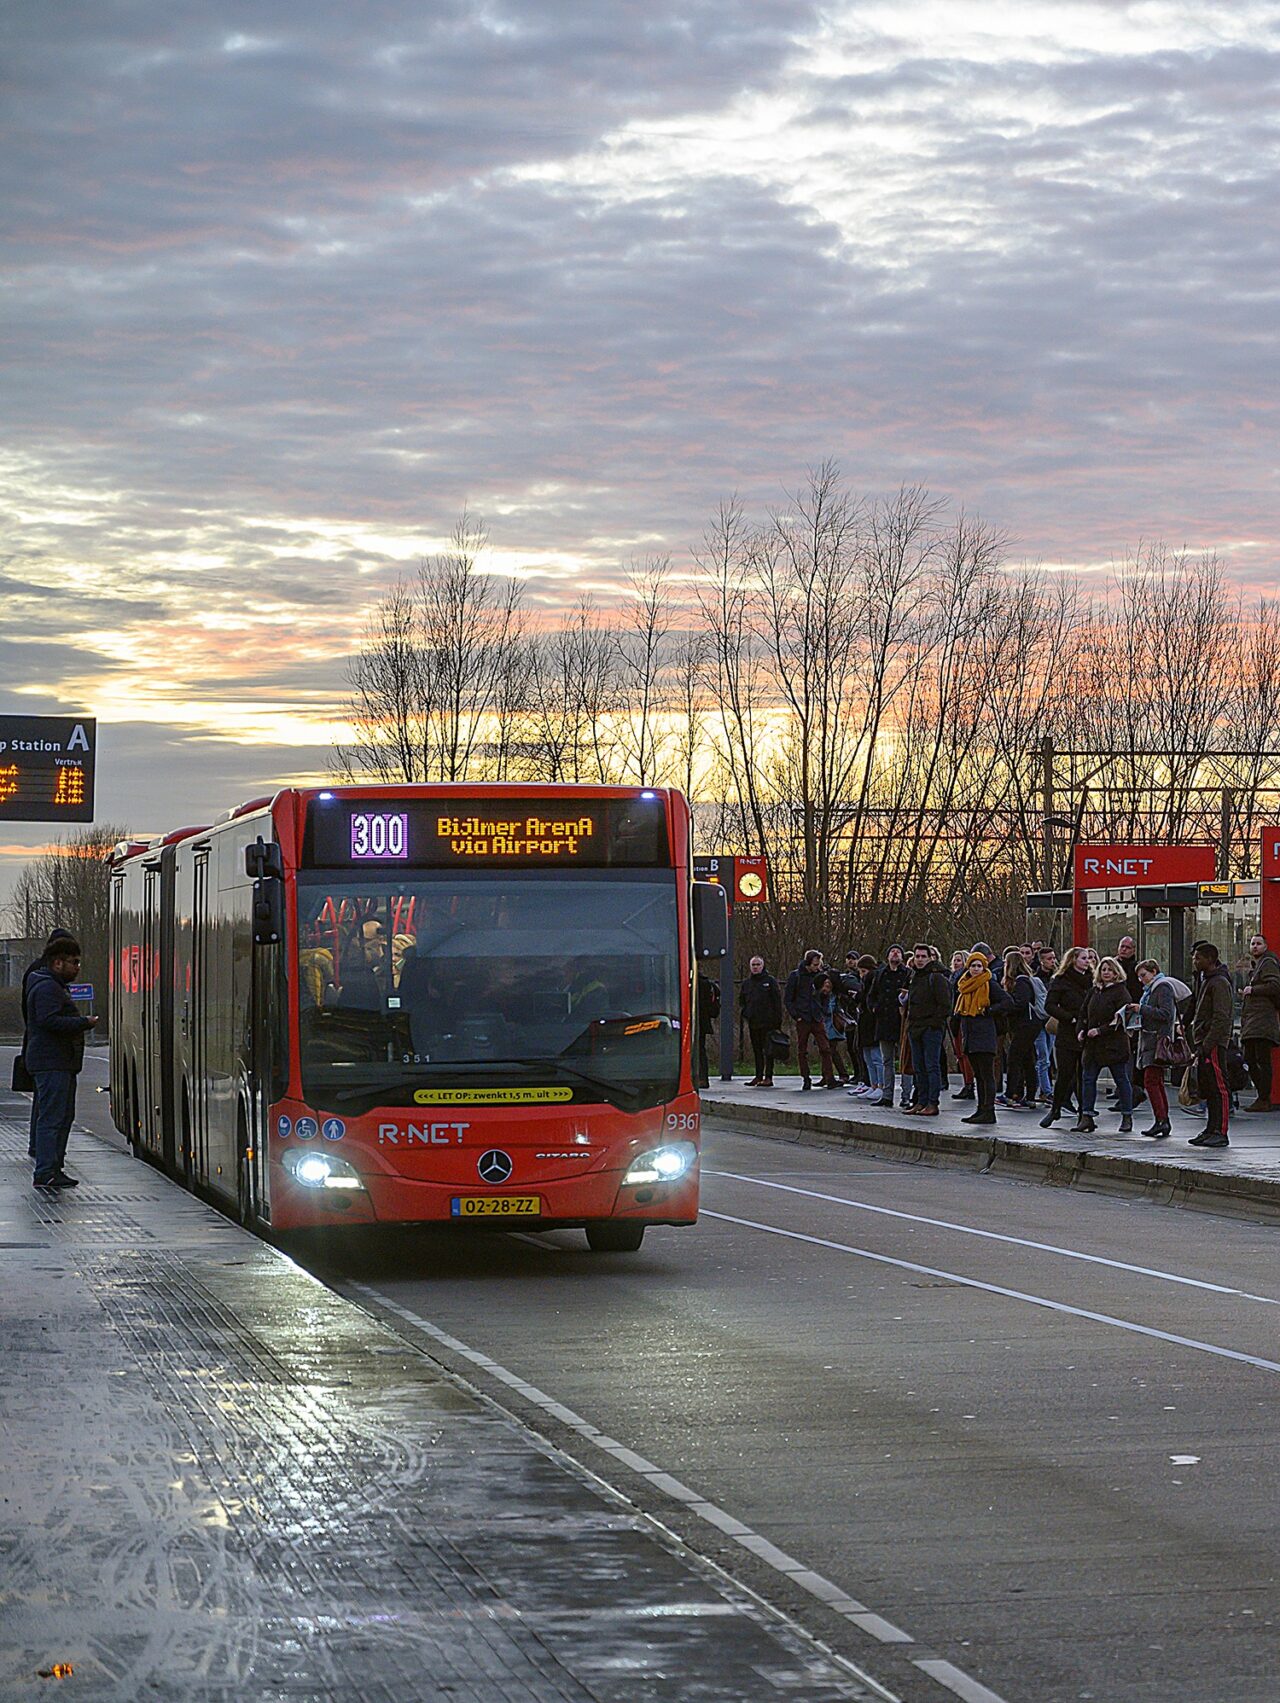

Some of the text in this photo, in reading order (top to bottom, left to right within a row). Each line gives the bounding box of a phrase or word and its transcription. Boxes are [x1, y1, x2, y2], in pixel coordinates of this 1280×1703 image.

[11, 739, 61, 751] Station
[67, 724, 90, 751] A
[438, 817, 521, 836] Bijlmer
[354, 815, 403, 855] 300
[451, 836, 578, 854] via Airport
[710, 859, 719, 871] B
[438, 1092, 453, 1100] LET
[455, 1092, 471, 1100] OP:
[473, 1091, 507, 1100] zwenkt
[537, 1090, 550, 1098] uit
[465, 1199, 534, 1213] 02-28-ZZ
